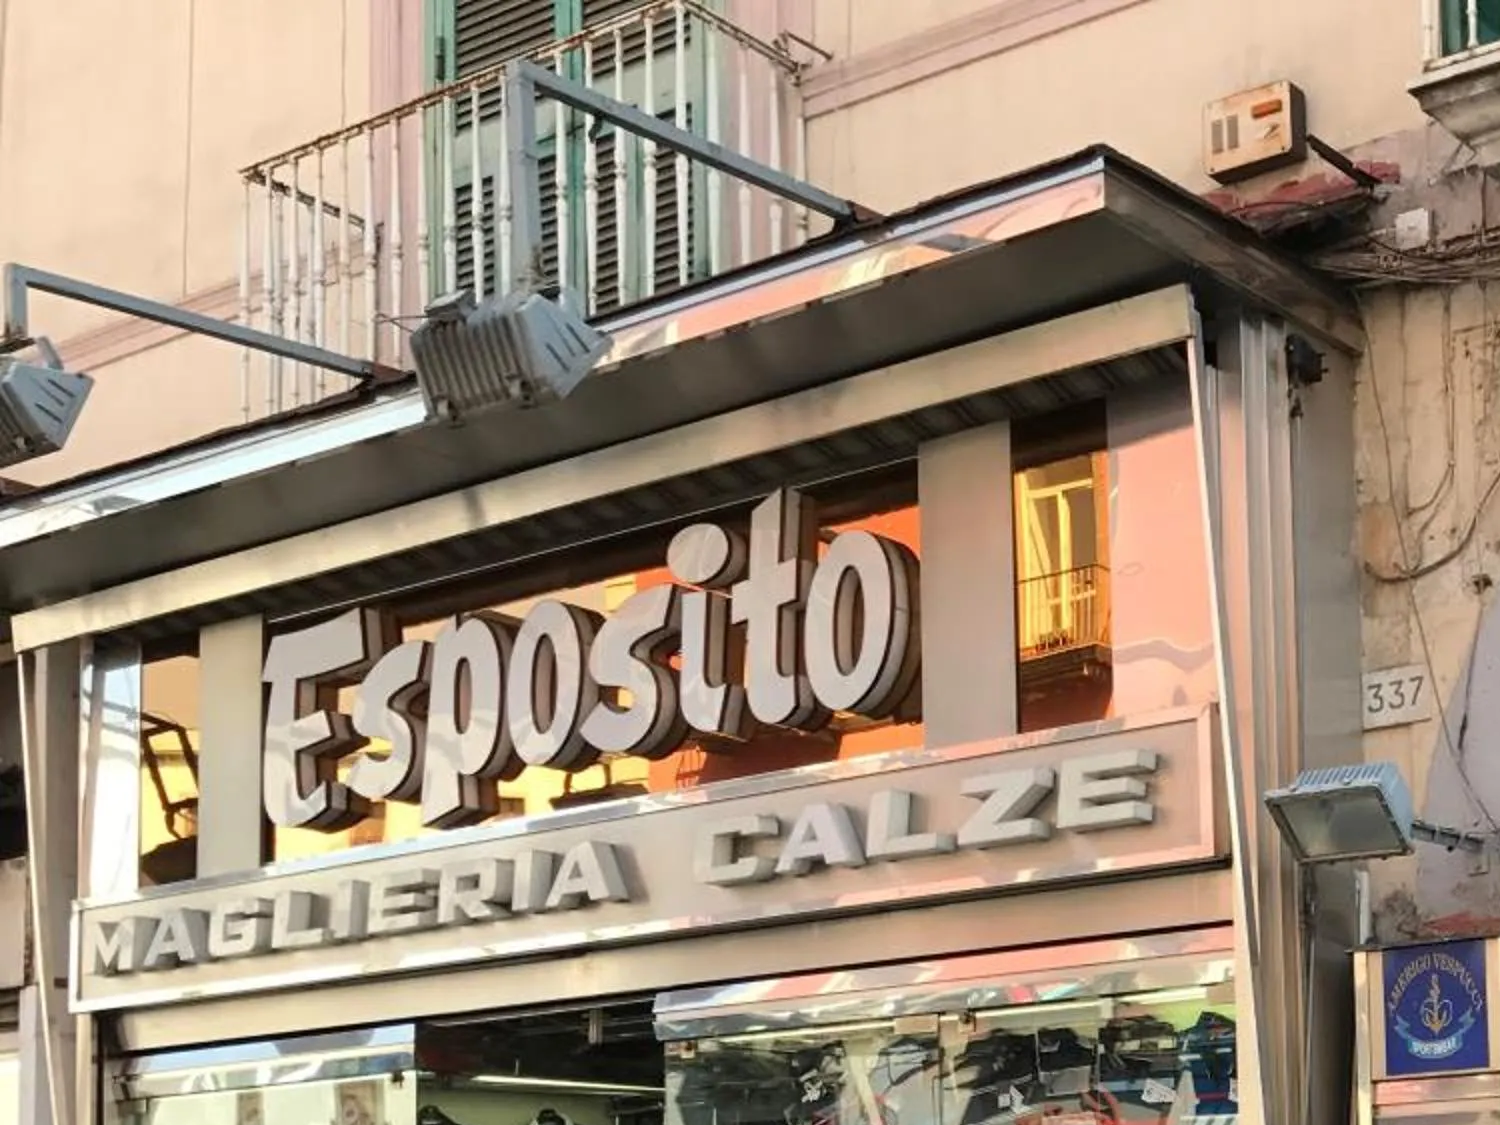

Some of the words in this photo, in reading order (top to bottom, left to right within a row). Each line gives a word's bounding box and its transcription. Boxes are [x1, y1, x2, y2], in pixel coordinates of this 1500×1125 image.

[259, 488, 922, 832] Esposito
[1367, 676, 1424, 713] 337
[84, 842, 632, 978] MAGLIERIA
[697, 748, 1160, 890] CALZE
